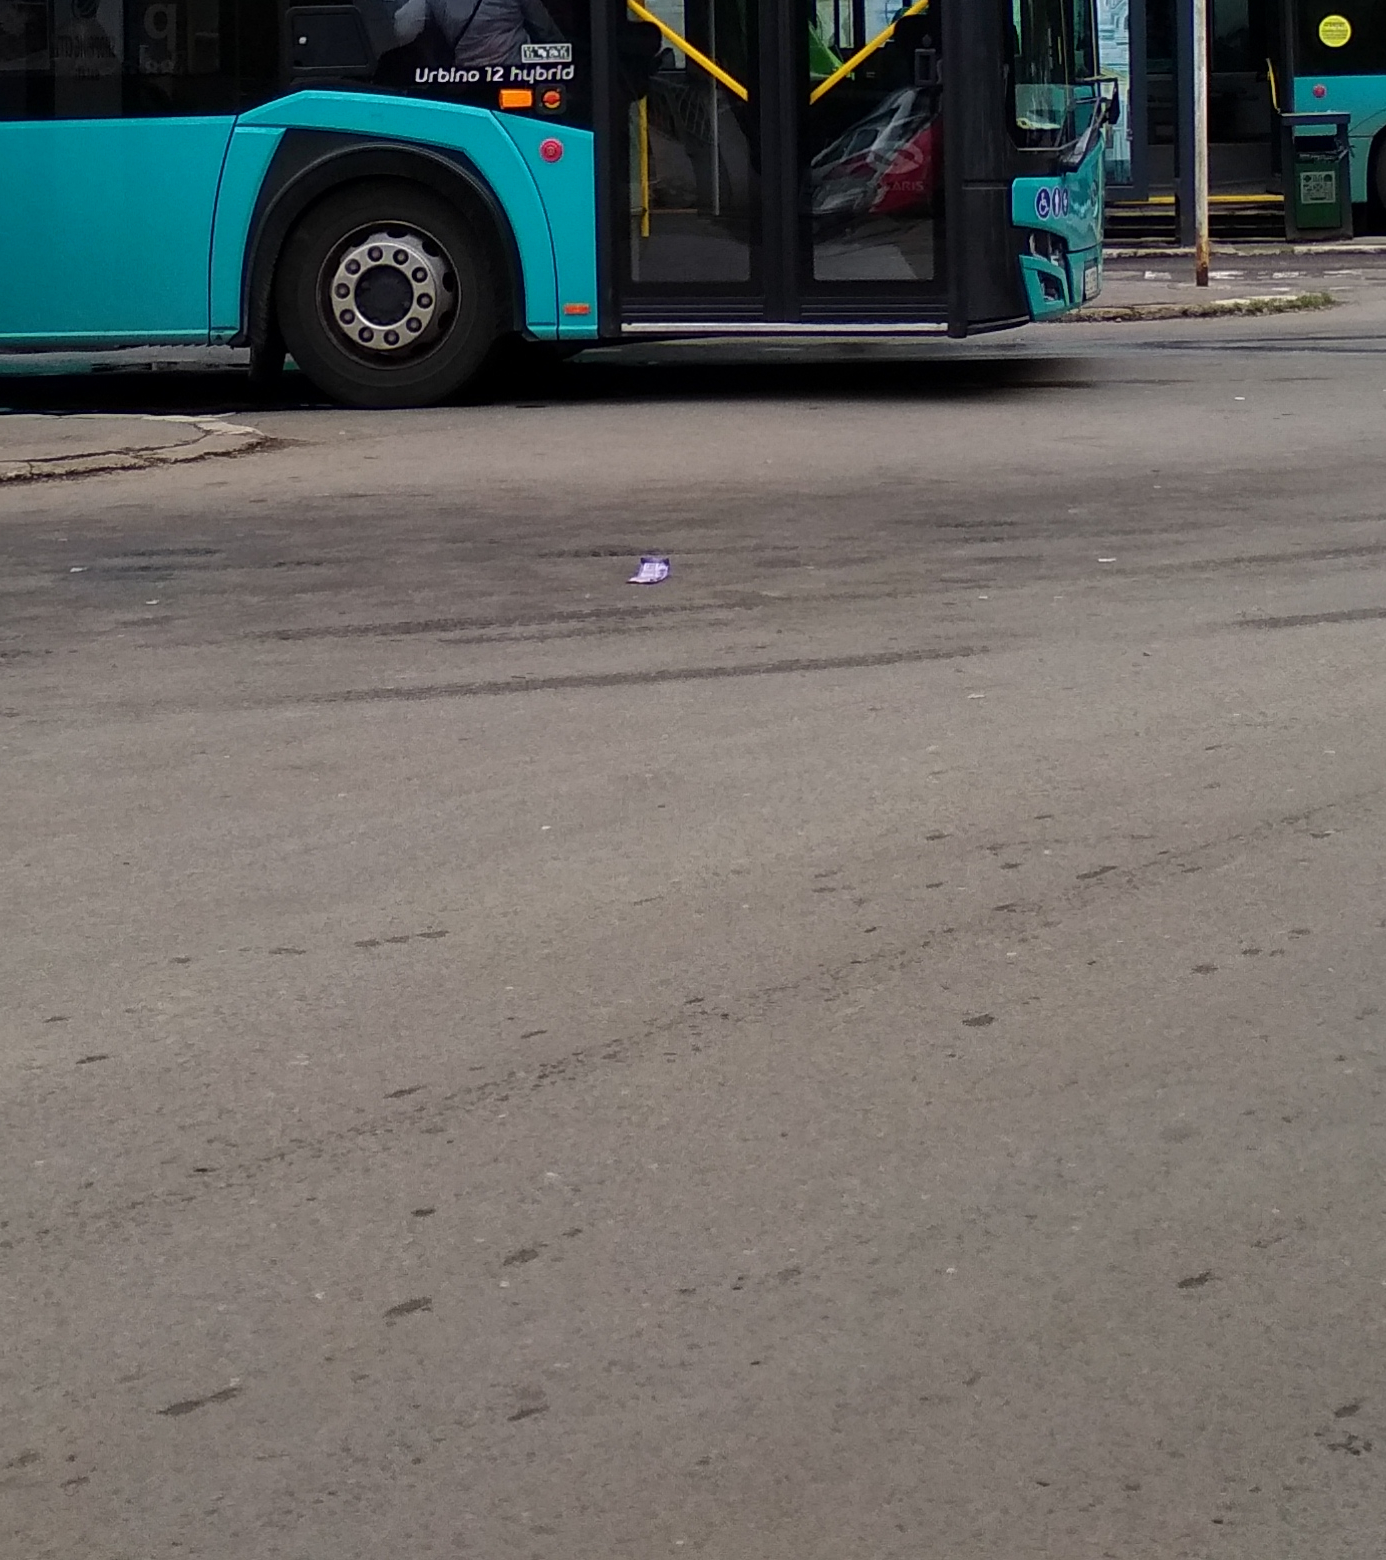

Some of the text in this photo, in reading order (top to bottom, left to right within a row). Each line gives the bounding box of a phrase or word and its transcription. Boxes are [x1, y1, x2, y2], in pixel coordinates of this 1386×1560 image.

[414, 64, 575, 85] Urbino 12 hybrid
